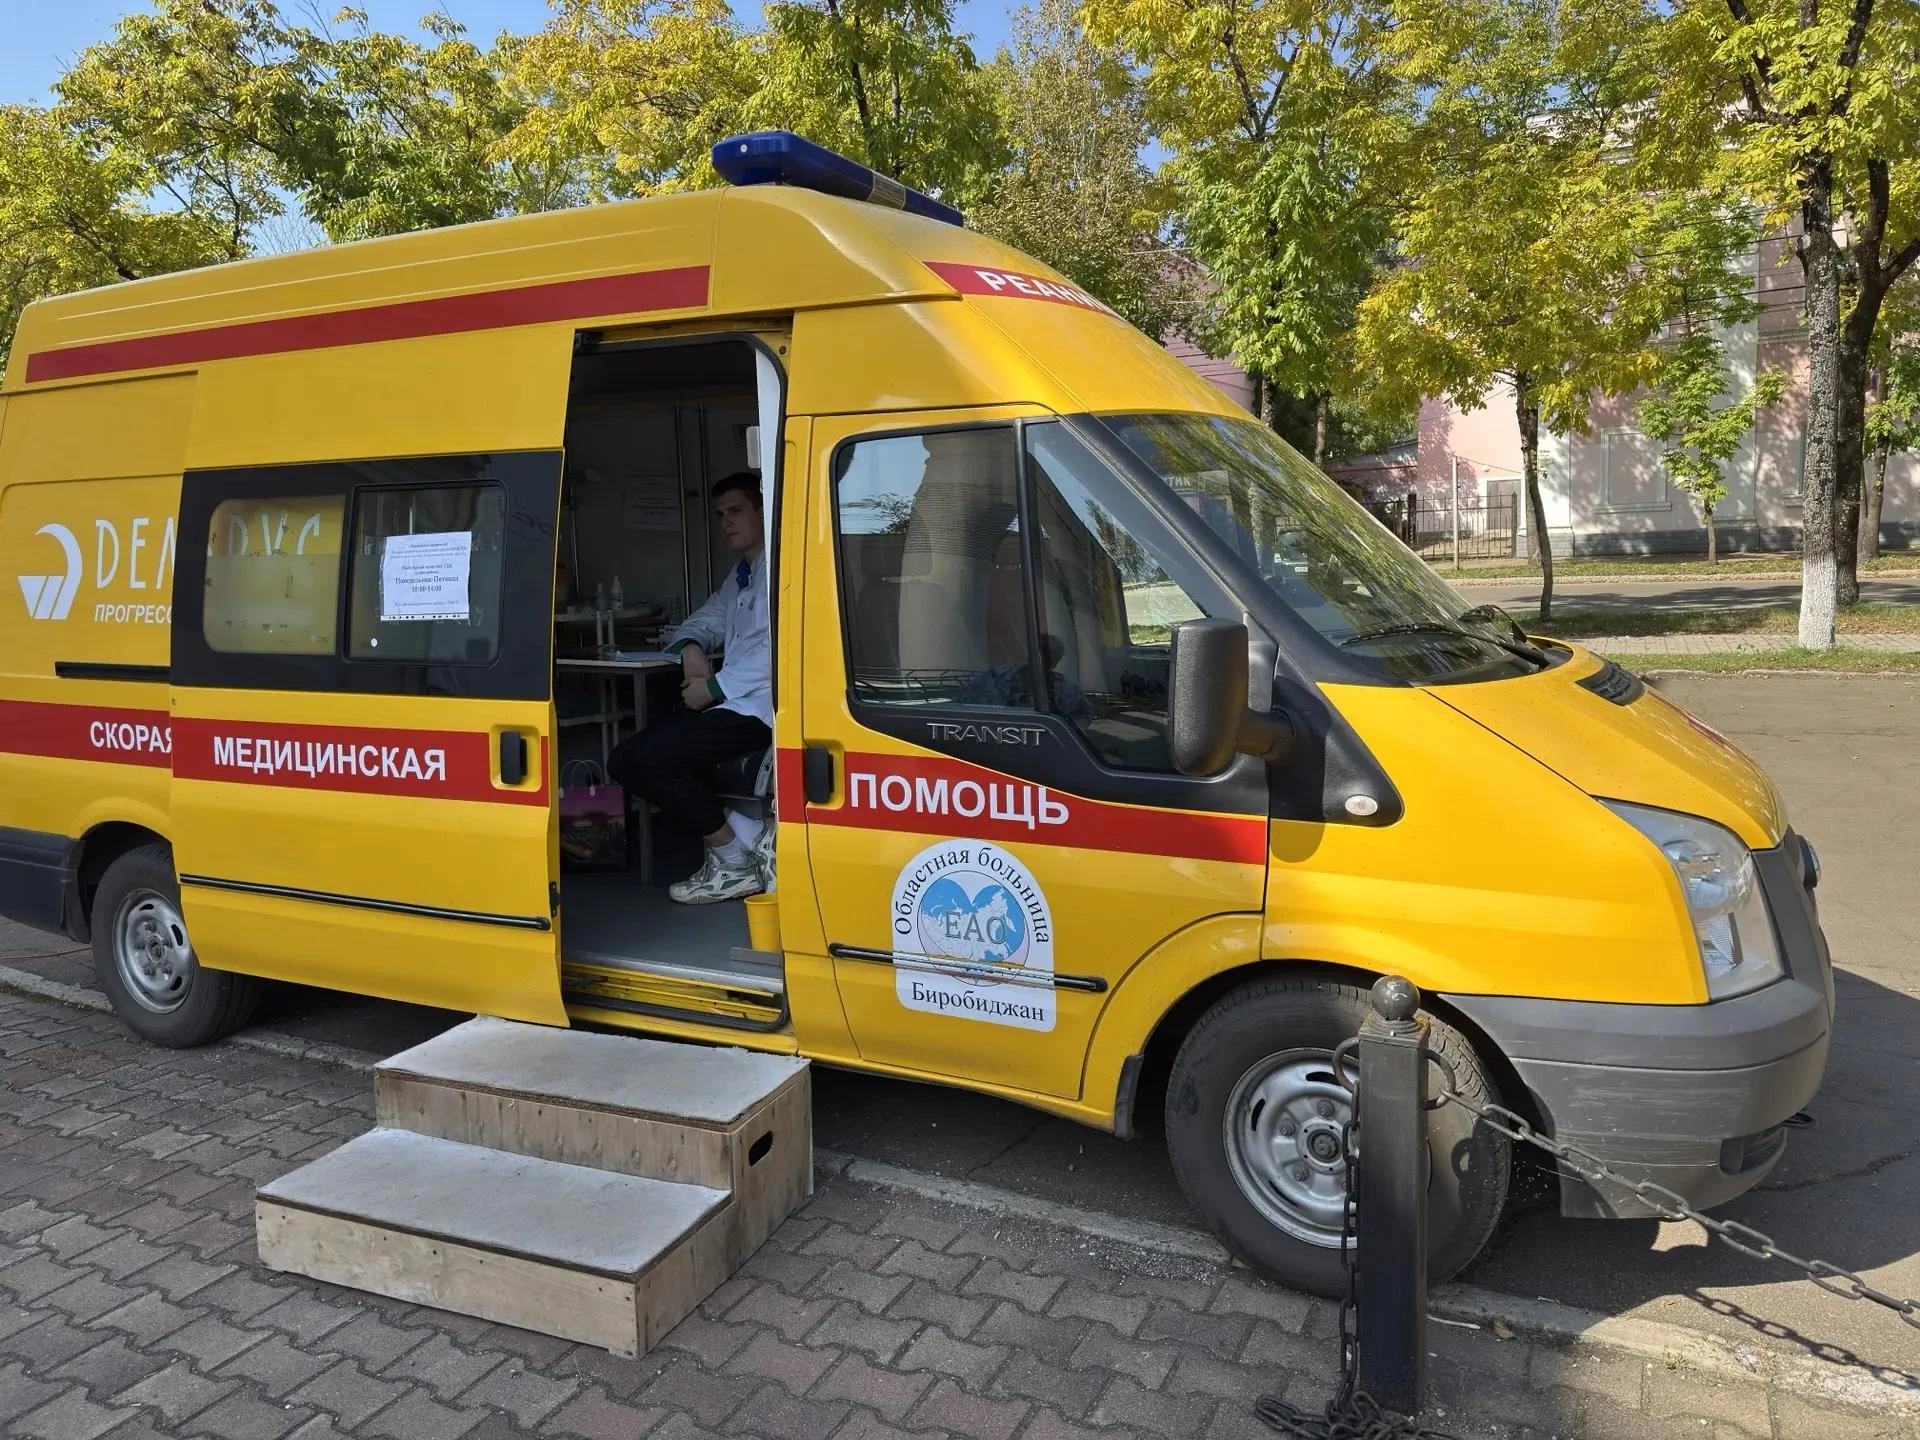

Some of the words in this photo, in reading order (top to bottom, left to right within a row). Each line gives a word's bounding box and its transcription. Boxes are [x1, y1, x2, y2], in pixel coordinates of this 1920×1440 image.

[926, 722, 1046, 746] TRANSIT
[213, 736, 446, 781] МЕДИЦИНСКАЯ
[850, 772, 1069, 830] ПОМОЩЬ
[894, 849, 970, 935] Областная
[977, 846, 1050, 944] больница
[942, 910, 1008, 945] ЕАО
[911, 981, 1045, 1022] Биробиджан
